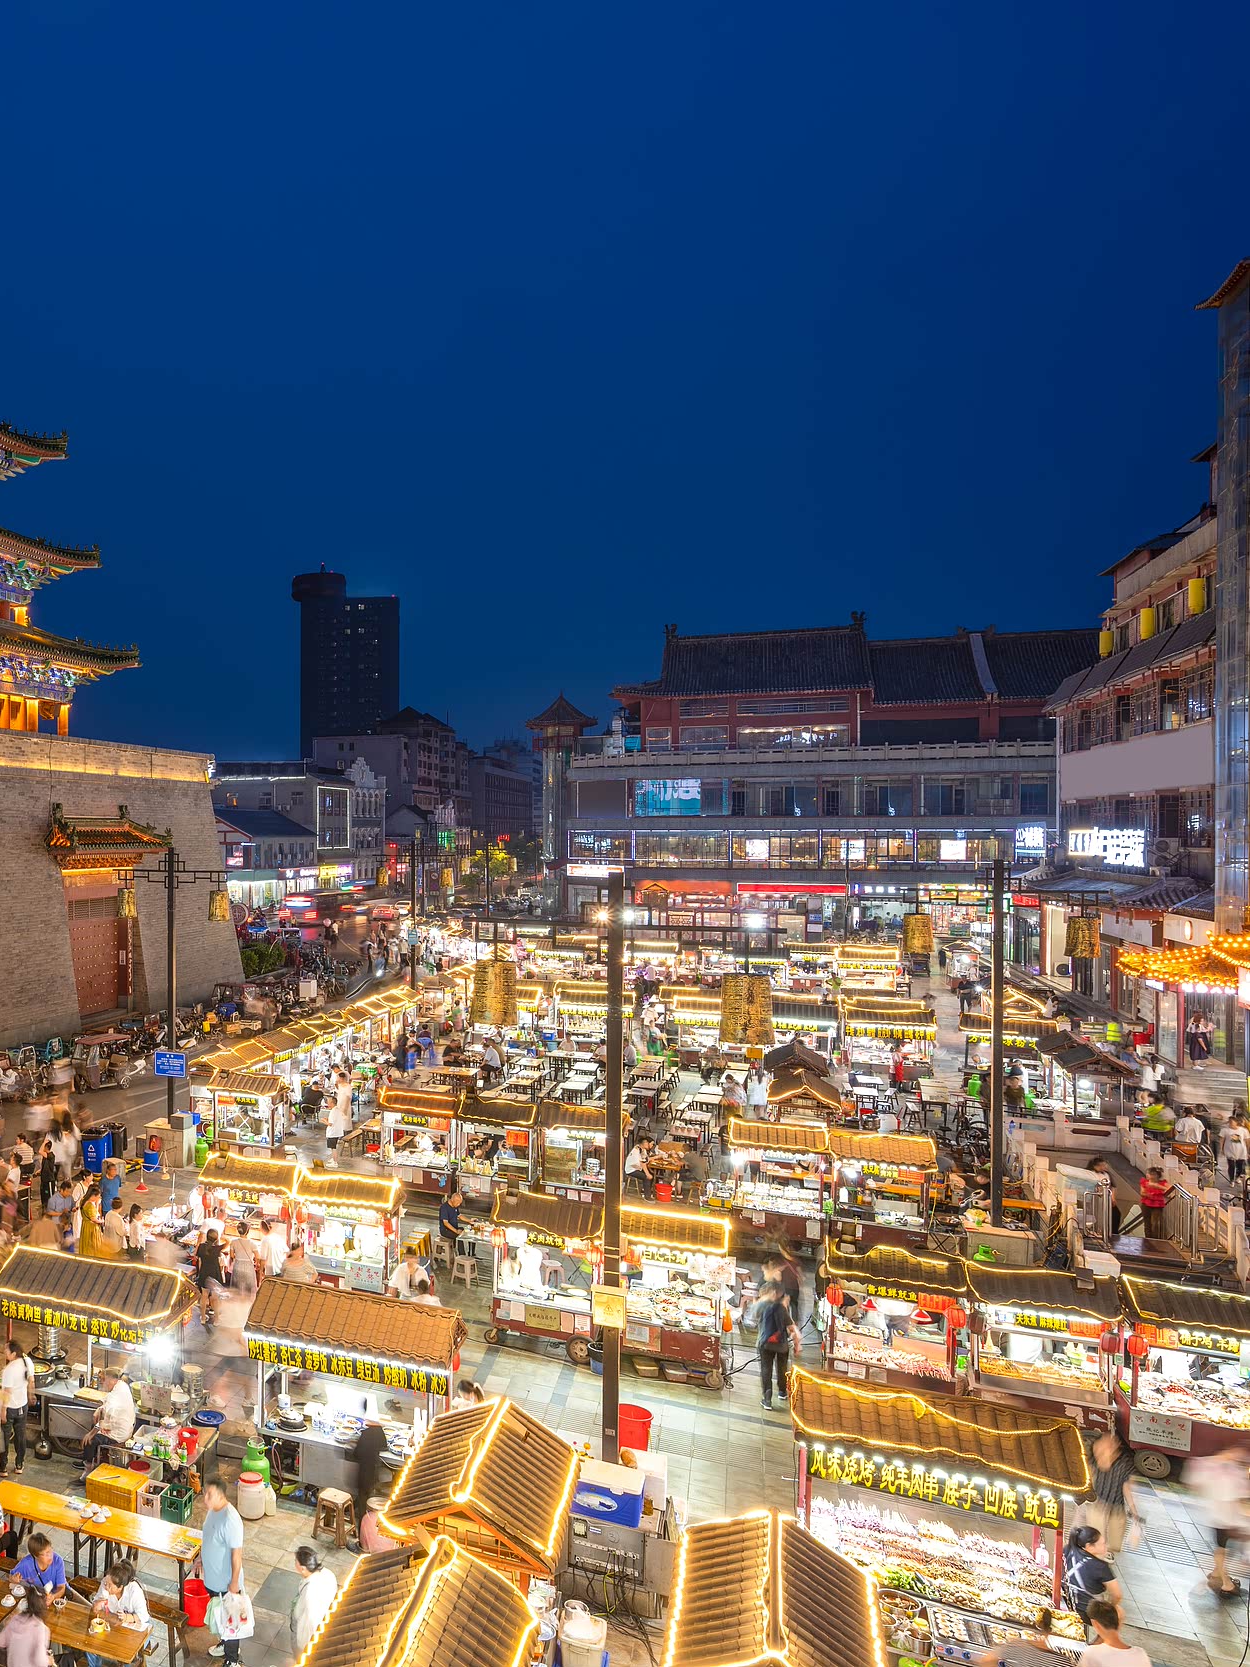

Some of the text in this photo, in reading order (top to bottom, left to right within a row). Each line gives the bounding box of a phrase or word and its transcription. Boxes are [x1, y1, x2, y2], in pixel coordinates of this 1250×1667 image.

[811, 1449, 876, 1488] 风味烧烤
[880, 1463, 940, 1502] 纯羊肉串
[942, 1476, 978, 1509] 腰子
[1023, 1491, 1060, 1528] 鱿鱼
